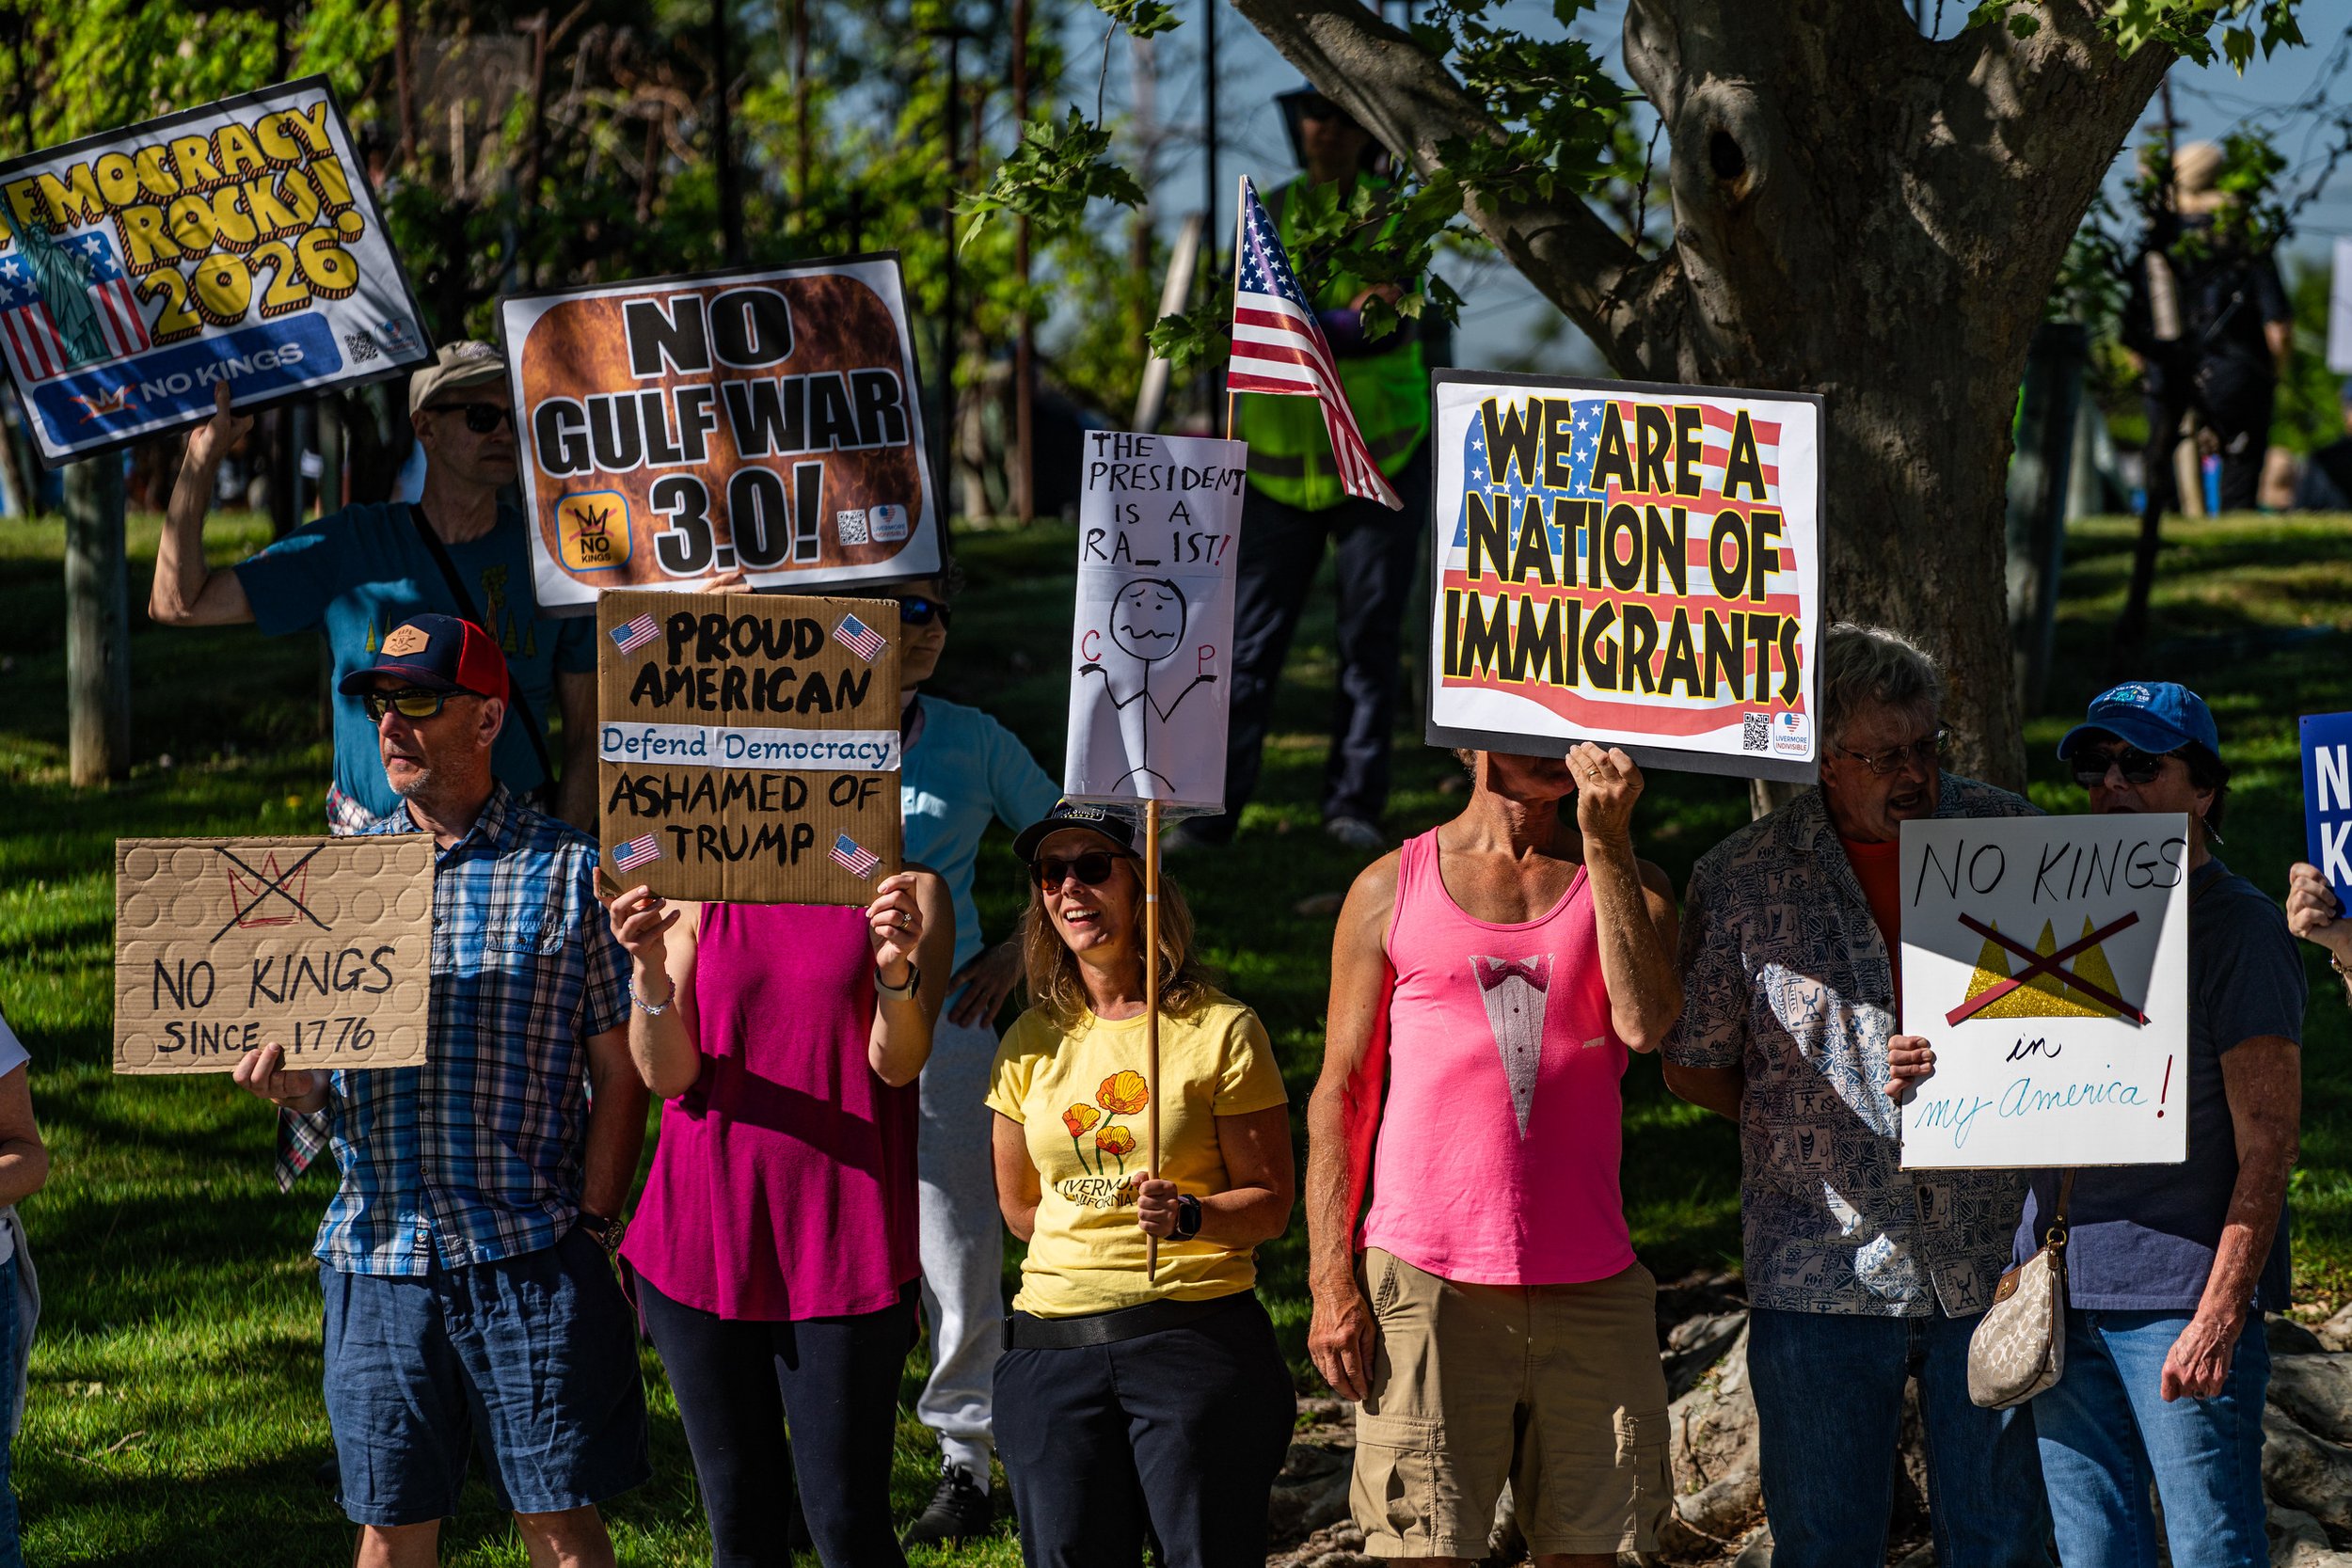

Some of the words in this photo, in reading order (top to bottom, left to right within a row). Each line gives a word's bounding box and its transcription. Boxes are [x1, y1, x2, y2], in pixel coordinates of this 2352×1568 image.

[0, 101, 333, 249] EMOCRACY
[113, 155, 365, 276] ROCKS!
[135, 228, 358, 346] 2026
[622, 287, 795, 379] NO
[140, 372, 192, 403] NO
[196, 342, 304, 387] KINGS
[532, 384, 717, 479] GULF
[722, 368, 910, 459] WAR
[1091, 432, 1156, 460] THE
[1480, 394, 1573, 491] WE
[1590, 399, 1704, 499] ARE
[1721, 408, 1768, 502] A
[1089, 461, 1246, 496] PRESIDENT
[649, 461, 824, 578] 3.0!
[1114, 502, 1141, 525] IS
[1168, 499, 1191, 526] A
[580, 536, 610, 554] NO
[581, 553, 612, 563] KINGS
[1465, 490, 1690, 598] NATION
[1708, 508, 1783, 605] OF
[665, 611, 824, 665] PROUD
[1081, 629, 1103, 662] C
[1197, 644, 1216, 674] P
[1441, 587, 1801, 708] IMMIGRANTS
[629, 661, 872, 713] AMERICAN
[602, 727, 707, 760] Defend
[724, 734, 890, 769] Democracy
[1775, 735, 1807, 744] LIVERMORE
[1775, 742, 1807, 752] INDIVISIBLE
[608, 771, 807, 818] ASHAMED
[828, 774, 882, 812] OF
[2315, 744, 2351, 812] N
[665, 822, 815, 866] TRUMP
[1914, 839, 2006, 908] NO
[2032, 838, 2187, 905] KINGS
[153, 958, 215, 1010] NO
[248, 945, 396, 1008] KINGS
[157, 1021, 261, 1056] SINCE
[294, 1017, 375, 1054] 1776
[2006, 1033, 2061, 1063] in
[1915, 1097, 1993, 1148] my
